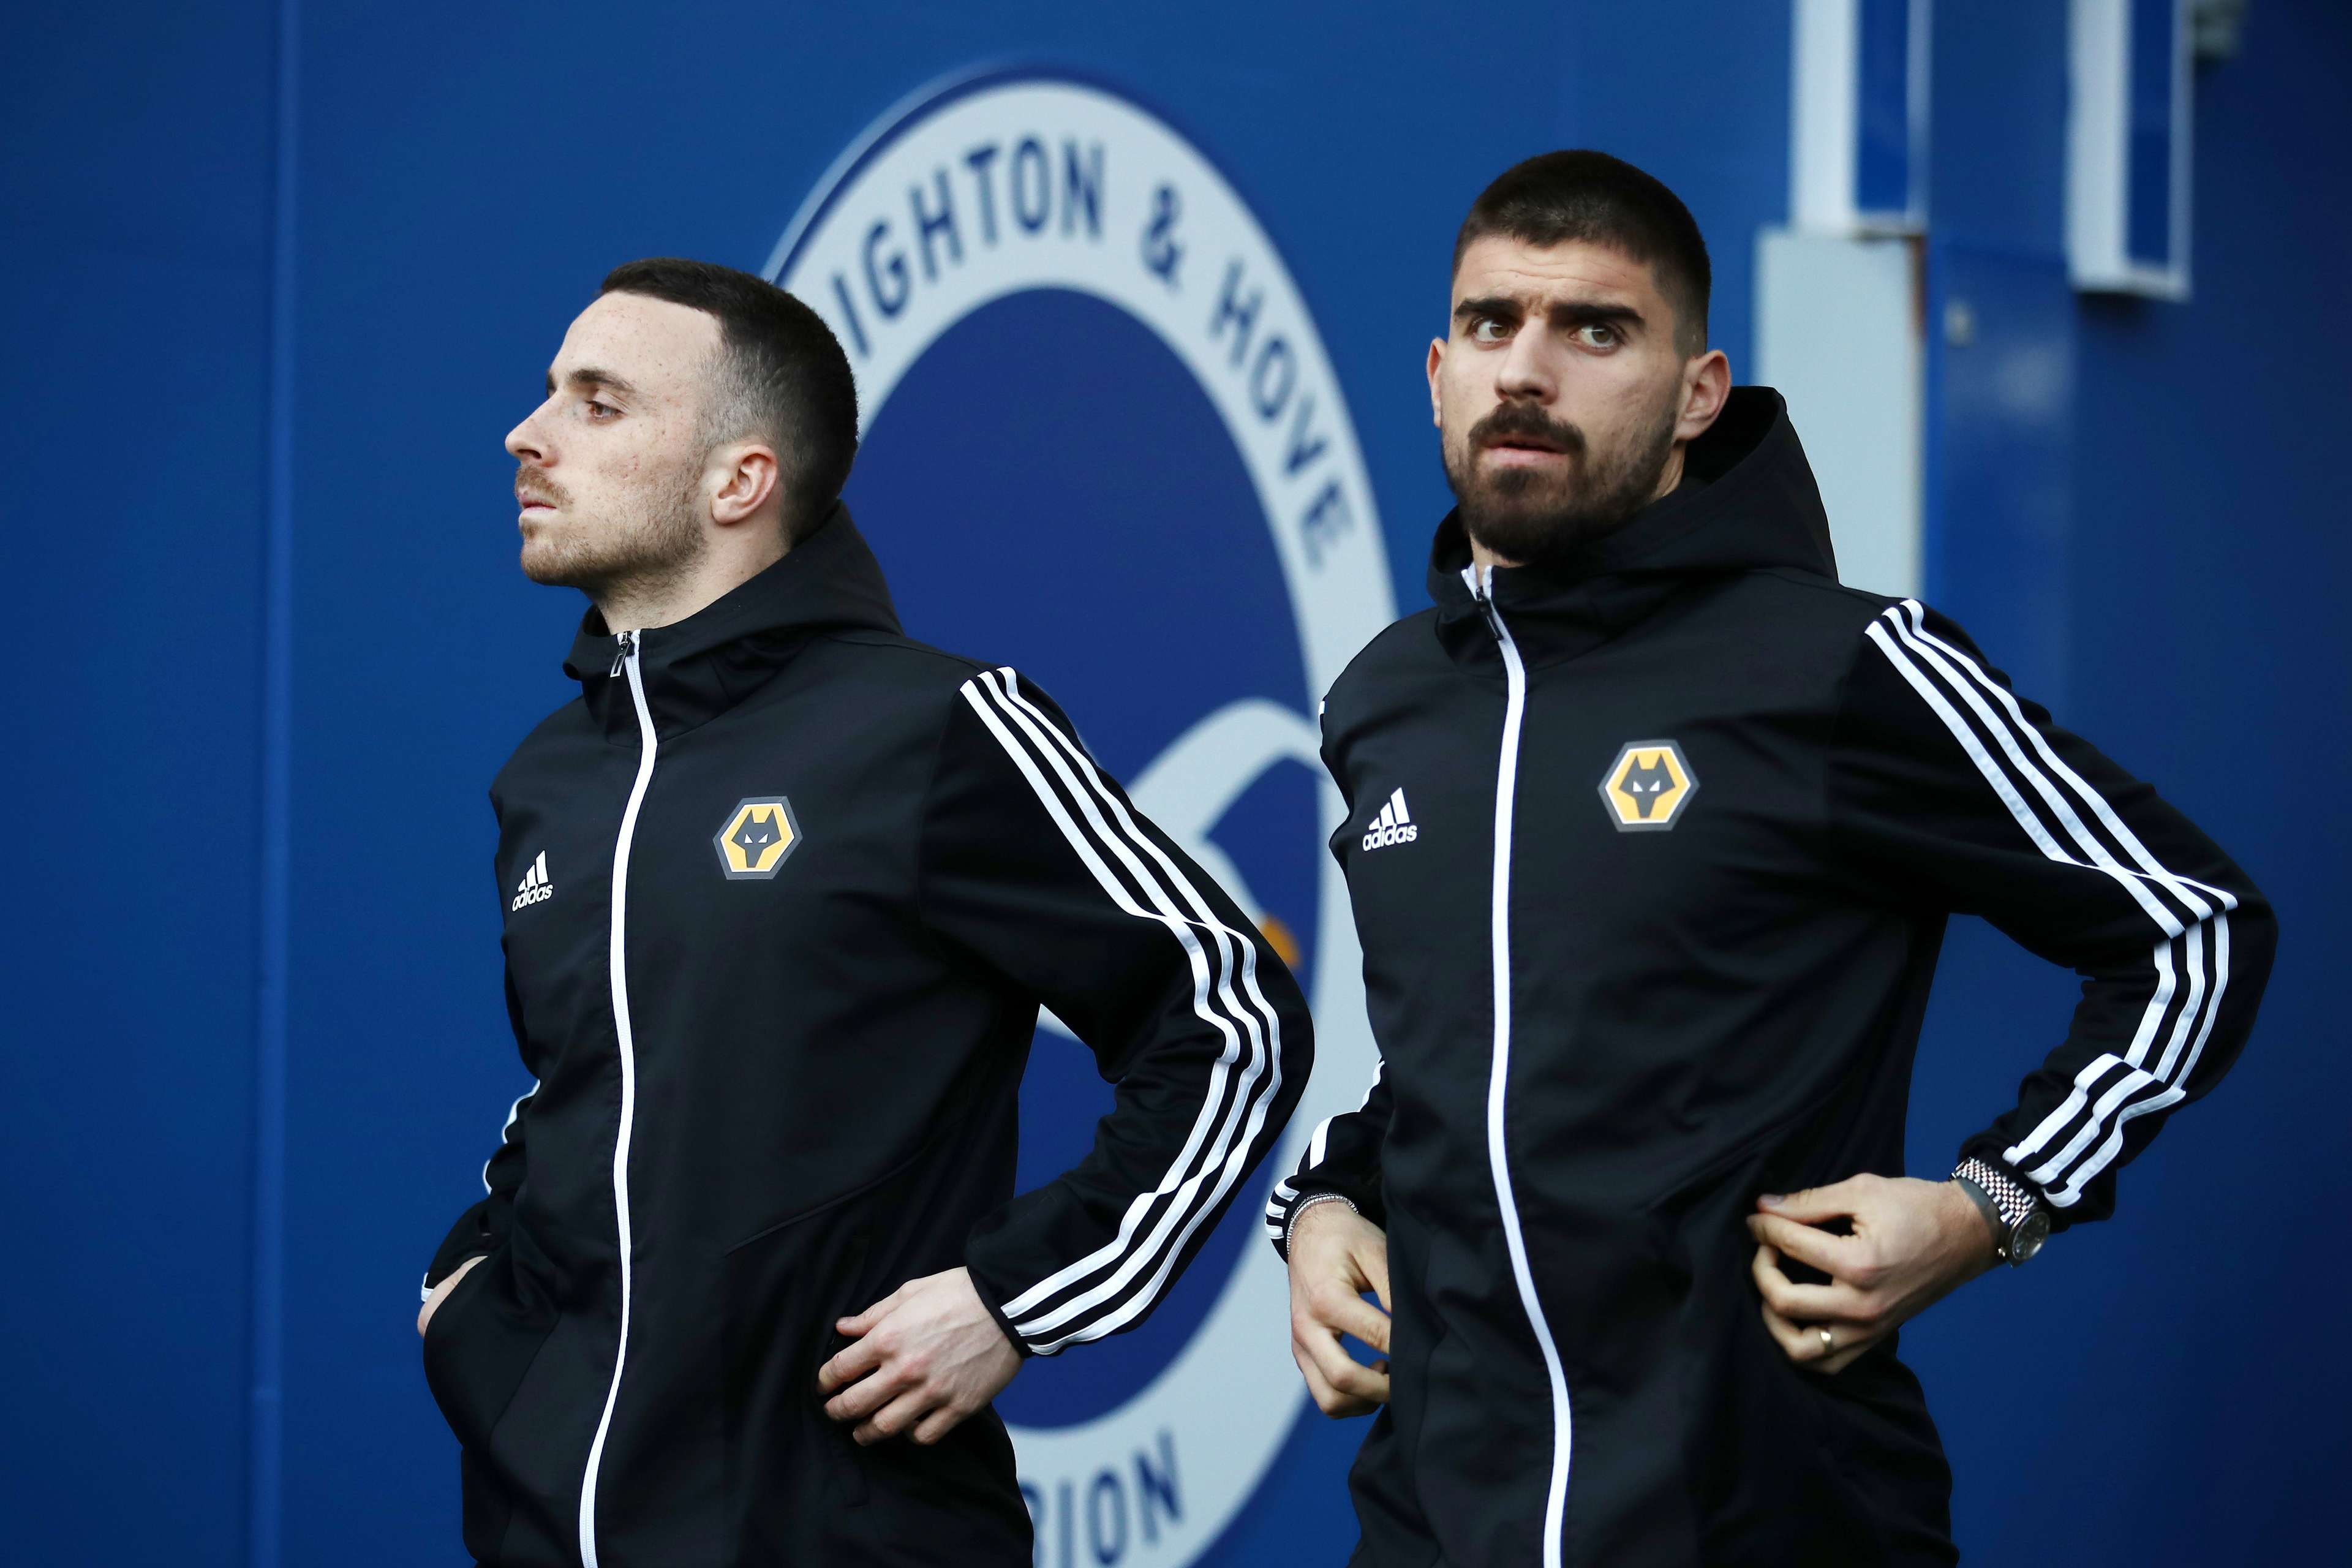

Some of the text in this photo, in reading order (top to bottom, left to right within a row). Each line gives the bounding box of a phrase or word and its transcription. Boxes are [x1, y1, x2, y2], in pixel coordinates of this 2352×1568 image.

[1140, 182, 1183, 293] &
[1208, 257, 1355, 572] HOVE
[1363, 822, 1417, 851] adidas
[512, 883, 554, 911] adidas
